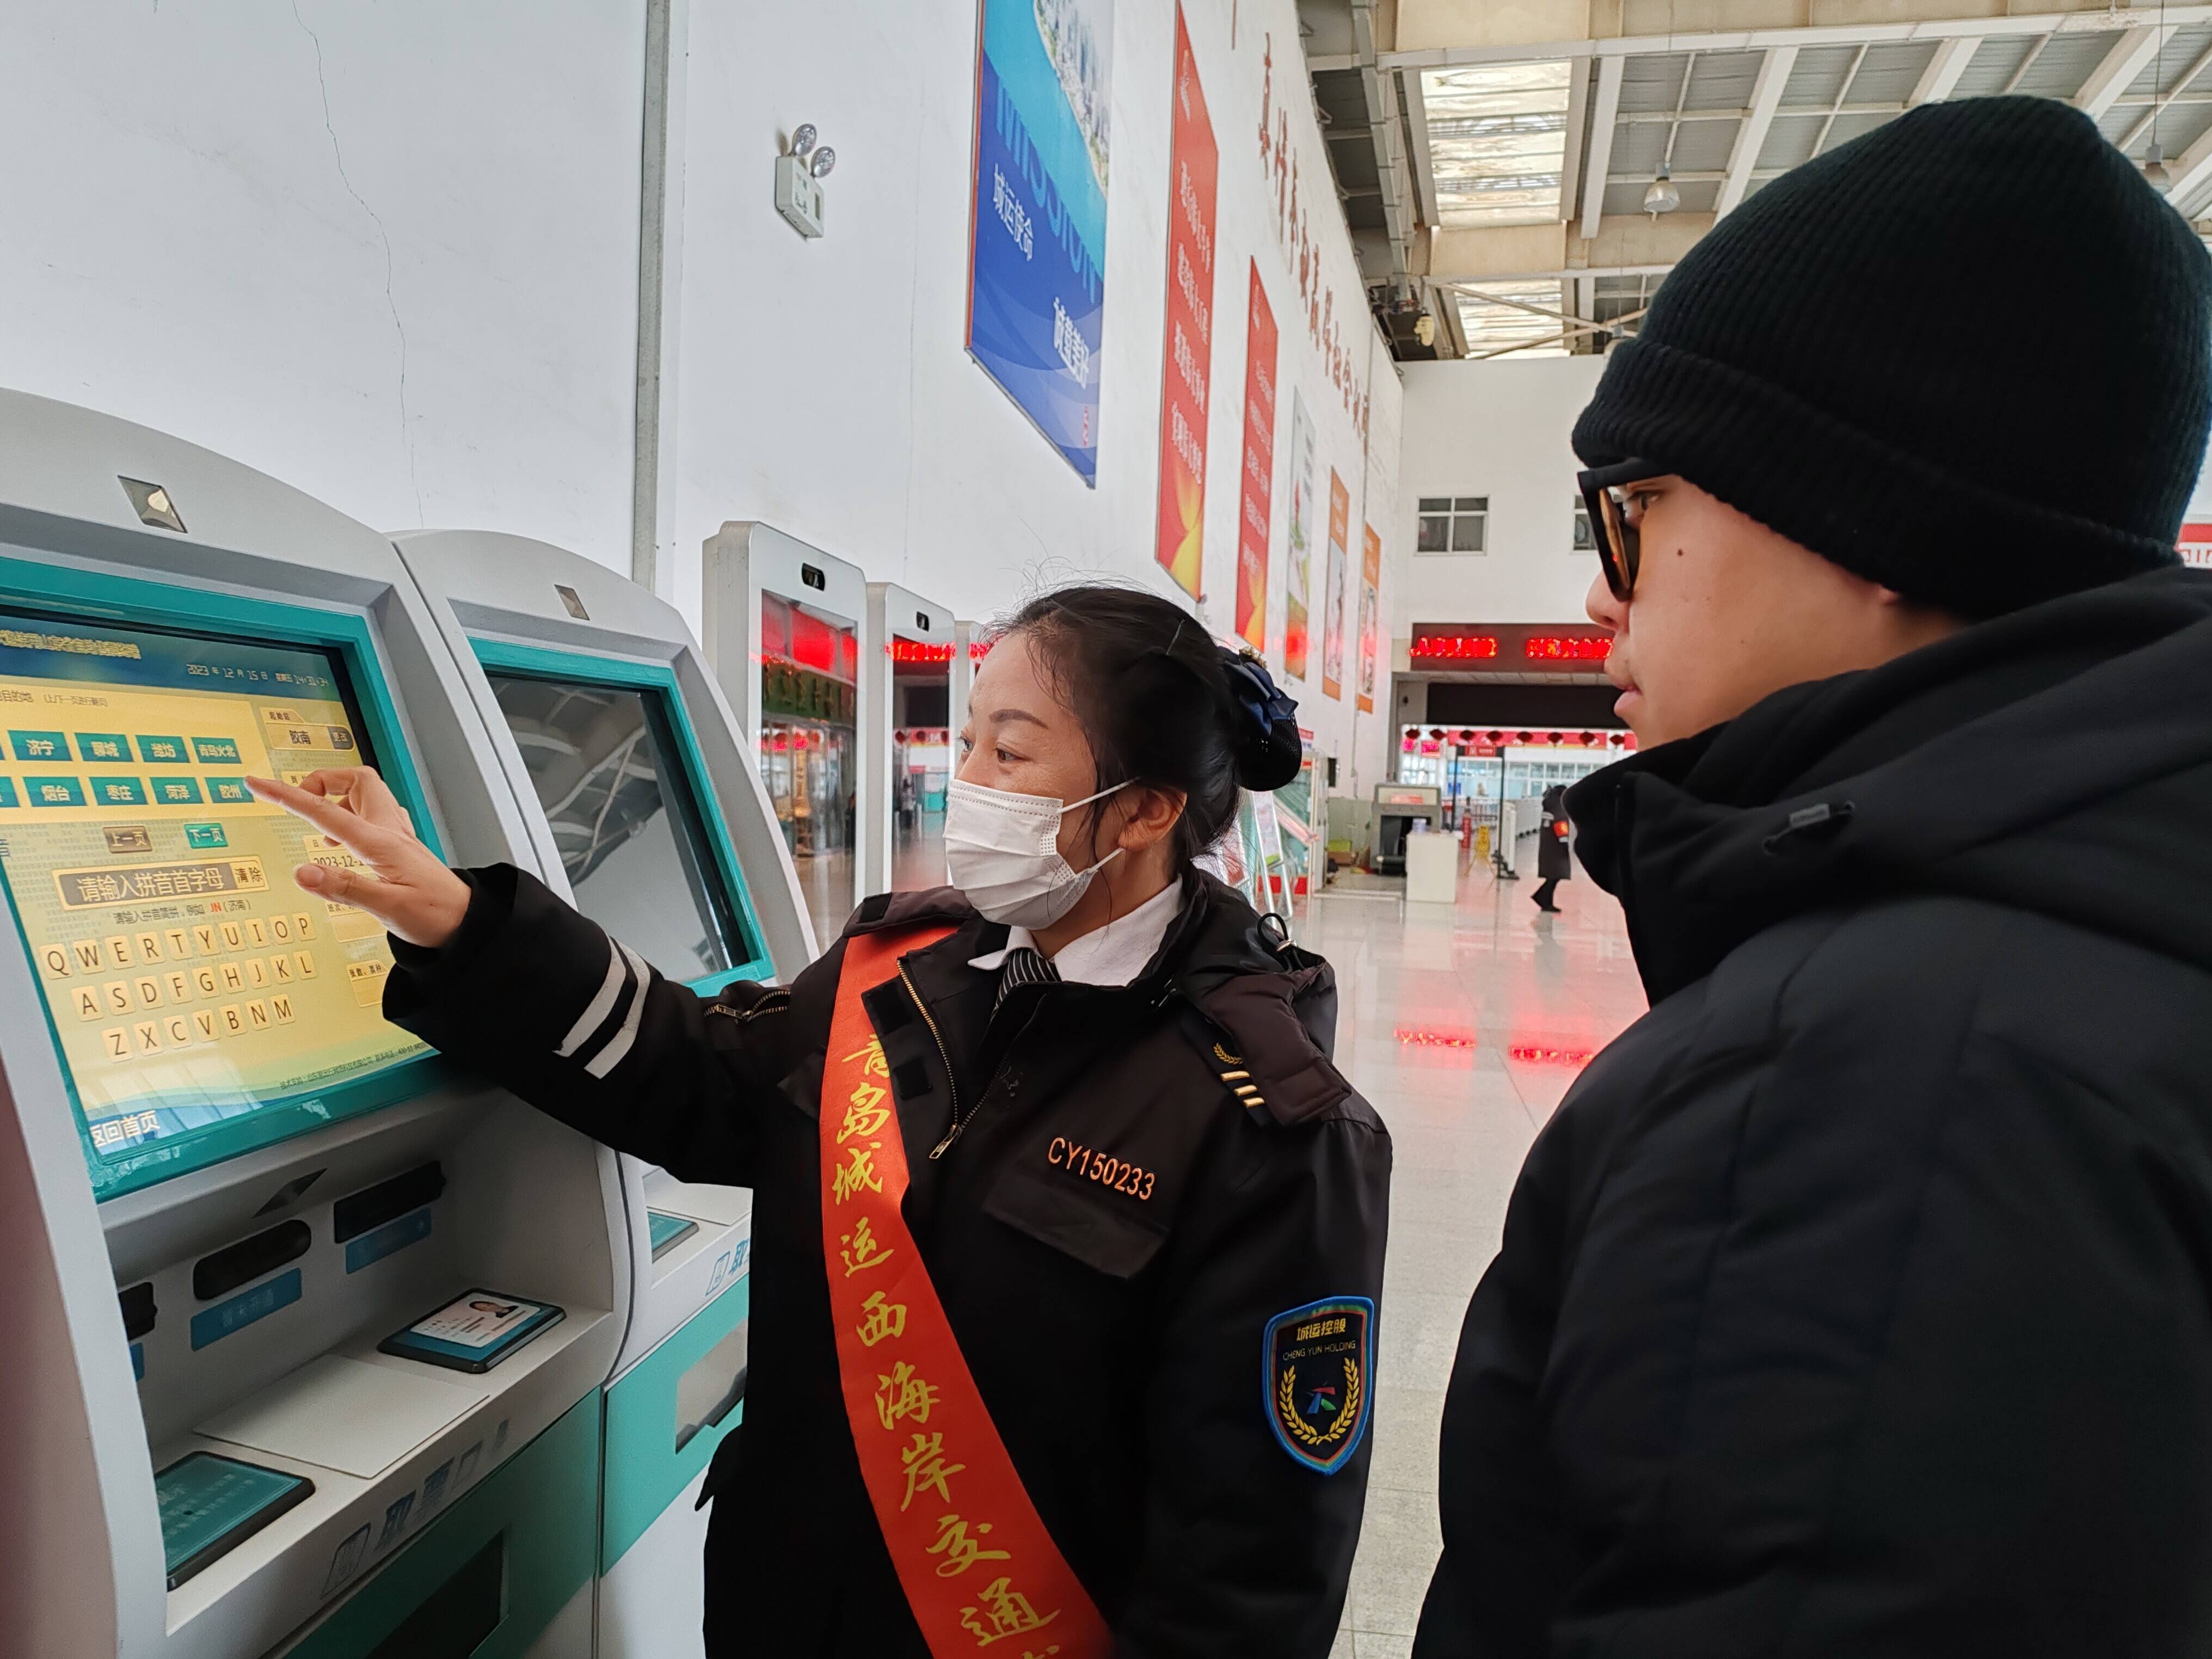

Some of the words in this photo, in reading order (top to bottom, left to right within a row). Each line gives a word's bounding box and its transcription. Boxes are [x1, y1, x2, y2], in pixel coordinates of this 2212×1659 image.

[993, 162, 1034, 262] 城运使命
[26, 739, 54, 756] 济宁
[289, 730, 311, 745] 胶南
[40, 785, 70, 802] 烟台
[111, 831, 147, 847] 上一页
[189, 827, 224, 843] 下一页
[76, 867, 224, 902] 请输入拼音首字母
[234, 867, 263, 884] 清除
[210, 902, 222, 913] JN
[48, 951, 69, 975] Q
[76, 945, 99, 967] W
[114, 942, 128, 962] E
[144, 938, 159, 958] R
[171, 934, 183, 953] T
[199, 930, 210, 949] Y
[225, 927, 238, 945] U
[253, 924, 262, 942] I
[275, 921, 288, 938] O
[298, 918, 308, 935] P
[82, 993, 97, 1015] A
[113, 987, 126, 1007] S
[142, 982, 157, 1003] D
[173, 977, 183, 997] F
[200, 973, 214, 991] G
[225, 968, 241, 987] H
[255, 964, 262, 982] J
[276, 960, 290, 978] K
[300, 956, 312, 973] L
[109, 1034, 127, 1055] Z
[140, 1027, 158, 1049] X
[172, 1022, 186, 1041] C
[198, 1015, 210, 1035] V
[227, 1010, 239, 1030] B
[251, 1004, 266, 1024] N
[274, 999, 292, 1019] M
[90, 1110, 161, 1147] 返回首页
[1048, 1137, 1156, 1201] CY150233
[1296, 1318, 1347, 1342] 城运控股
[832, 1034, 1061, 1658] 青岛城运西海岸交通
[1282, 1348, 1306, 1361] CHENG
[1307, 1345, 1323, 1356] YUN
[1324, 1340, 1356, 1353] HOLDING
